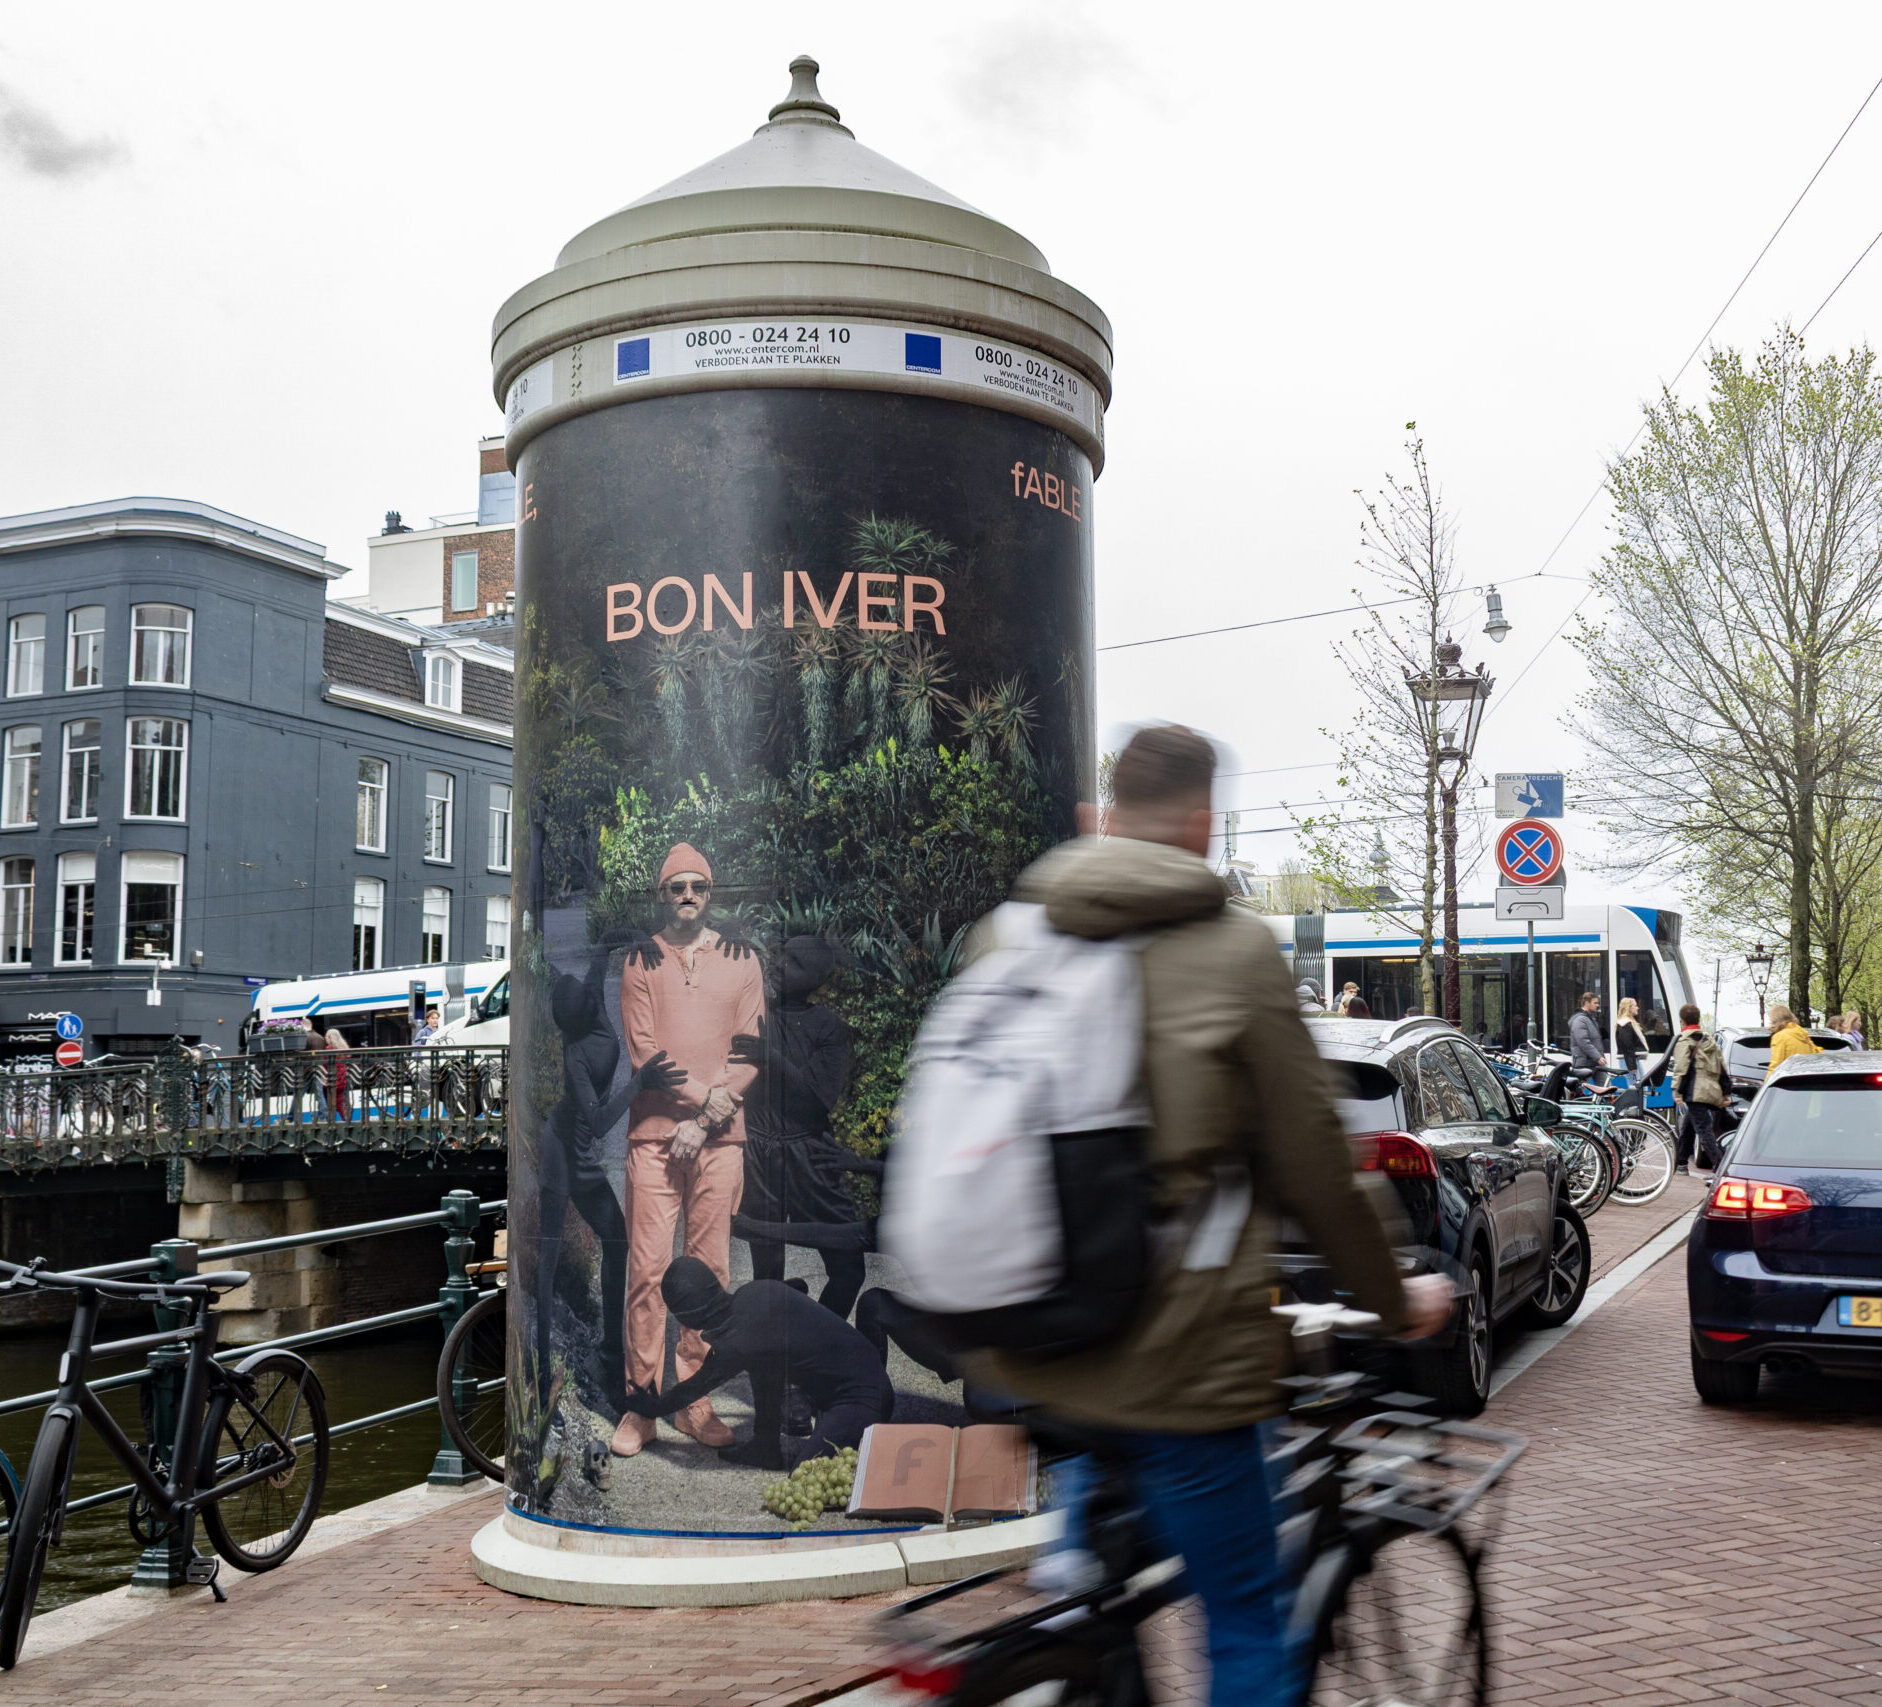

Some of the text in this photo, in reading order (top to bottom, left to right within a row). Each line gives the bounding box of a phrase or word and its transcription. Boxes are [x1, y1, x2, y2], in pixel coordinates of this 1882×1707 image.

[686, 329, 732, 347] 0800
[752, 327, 789, 343] 024
[796, 327, 819, 343] 24
[828, 328, 851, 344] 10
[714, 344, 820, 355] www.centercom.nl
[695, 355, 841, 368] VERBODEN AAN TE PLAKKEN
[906, 365, 941, 374] CENTERCOM
[975, 345, 1012, 368] 0800
[1026, 360, 1048, 381] 024
[1052, 369, 1064, 388] 24
[1068, 378, 1078, 395] 10
[999, 369, 1065, 398] www.centercom.nl
[983, 374, 1074, 413] VERBODEN AAN TE PLAKKEN
[606, 570, 946, 642] BON IVER
[9, 1034, 52, 1042] MAC
[16, 1054, 53, 1062] MAC
